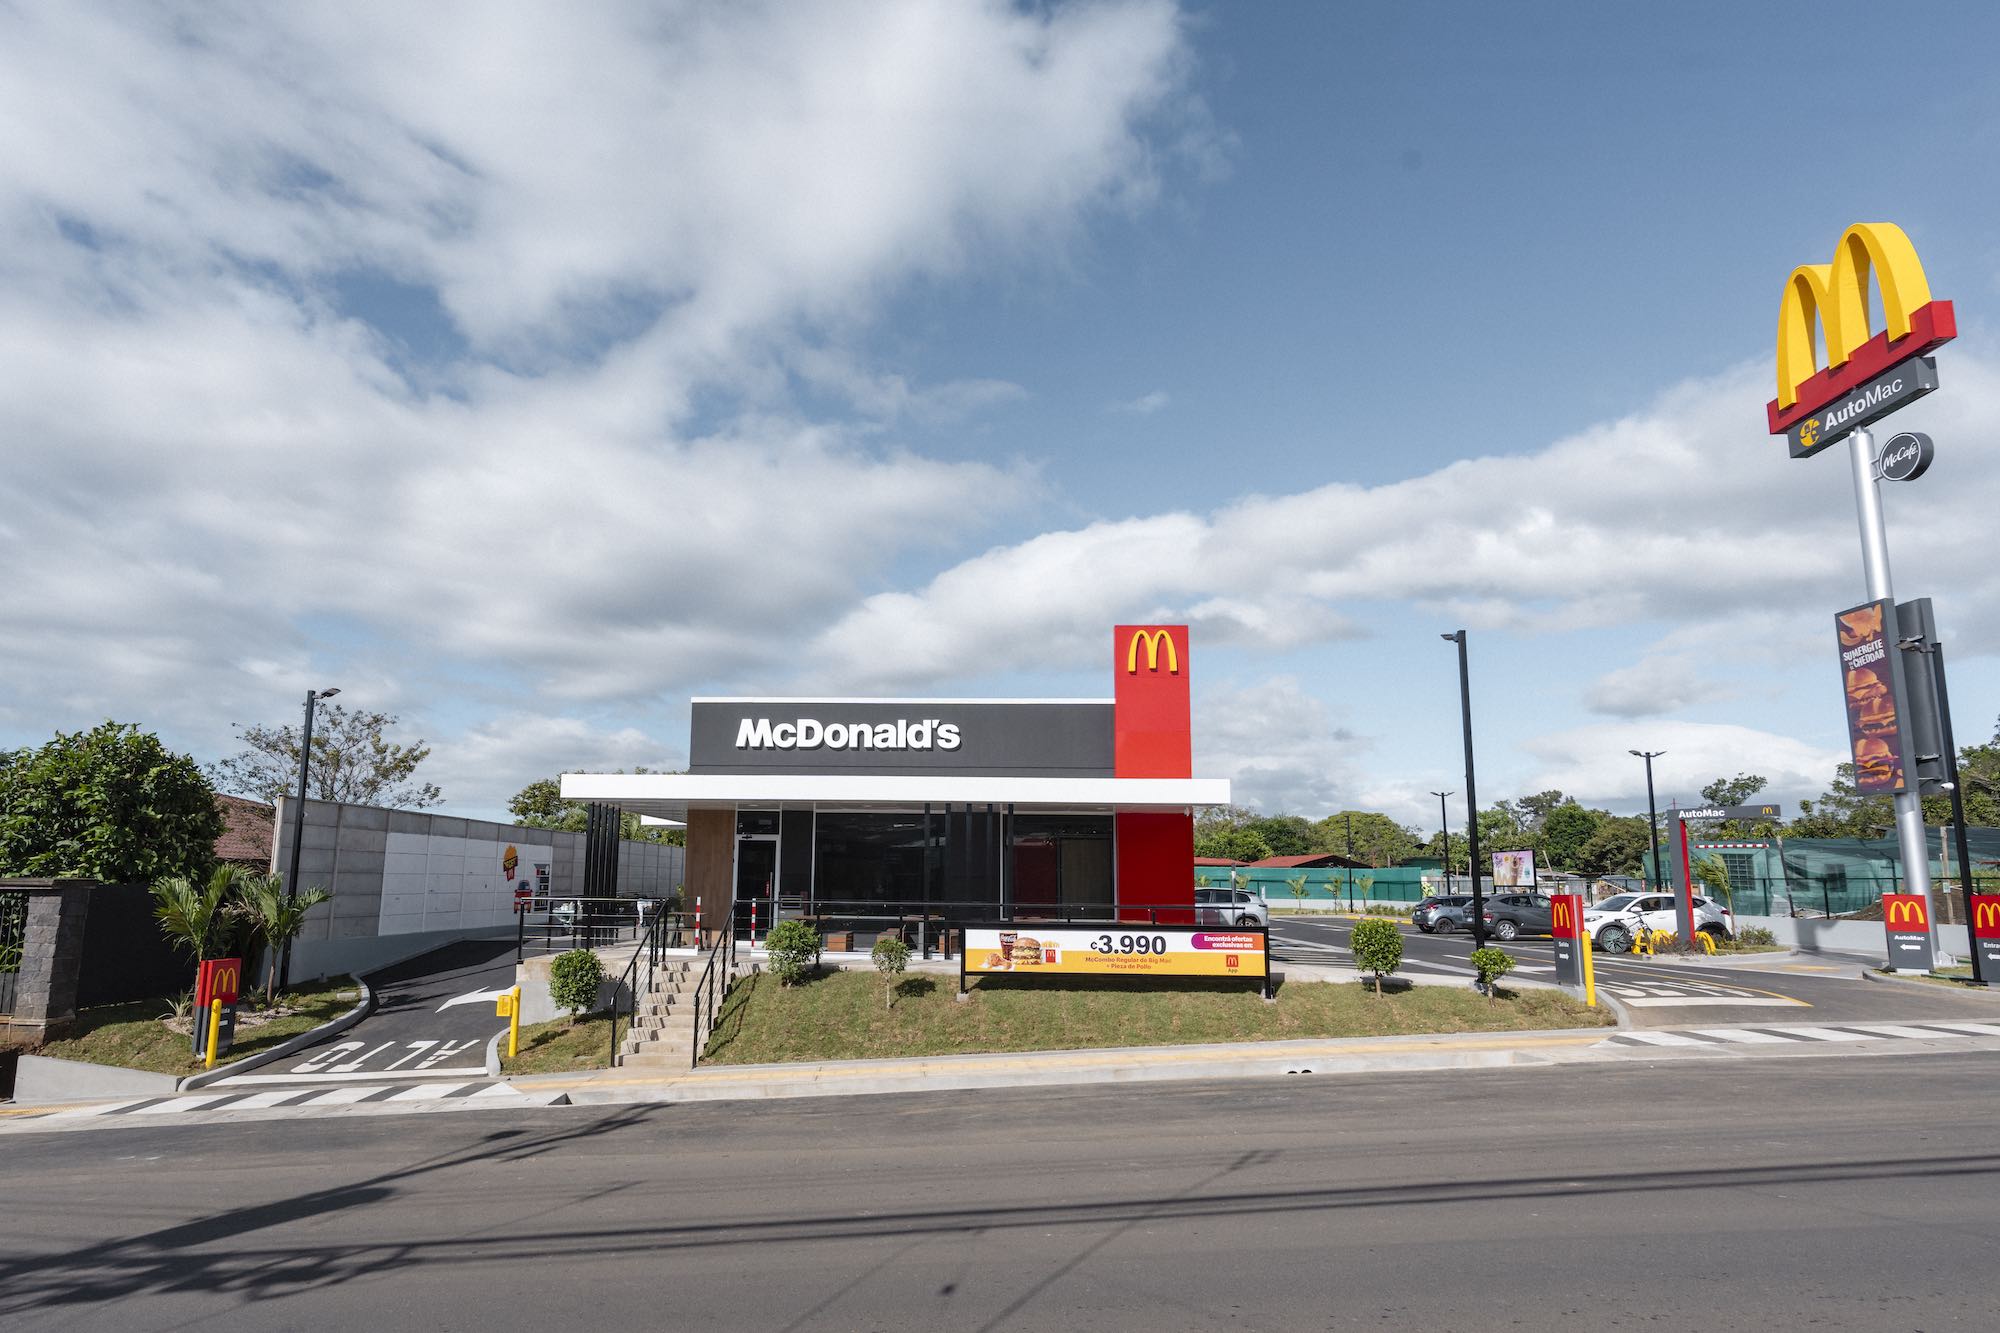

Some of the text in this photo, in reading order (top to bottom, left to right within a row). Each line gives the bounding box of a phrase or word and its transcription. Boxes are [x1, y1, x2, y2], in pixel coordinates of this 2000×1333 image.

[1825, 378, 1903, 431] AutoMac
[1852, 649, 1886, 668] CHEDDAR
[735, 717, 961, 750] McDonald's
[1678, 809, 1726, 819] AutoMac
[1983, 941, 2000, 949] Entra
[1116, 957, 1139, 965] Regular
[1148, 958, 1158, 966] Big
